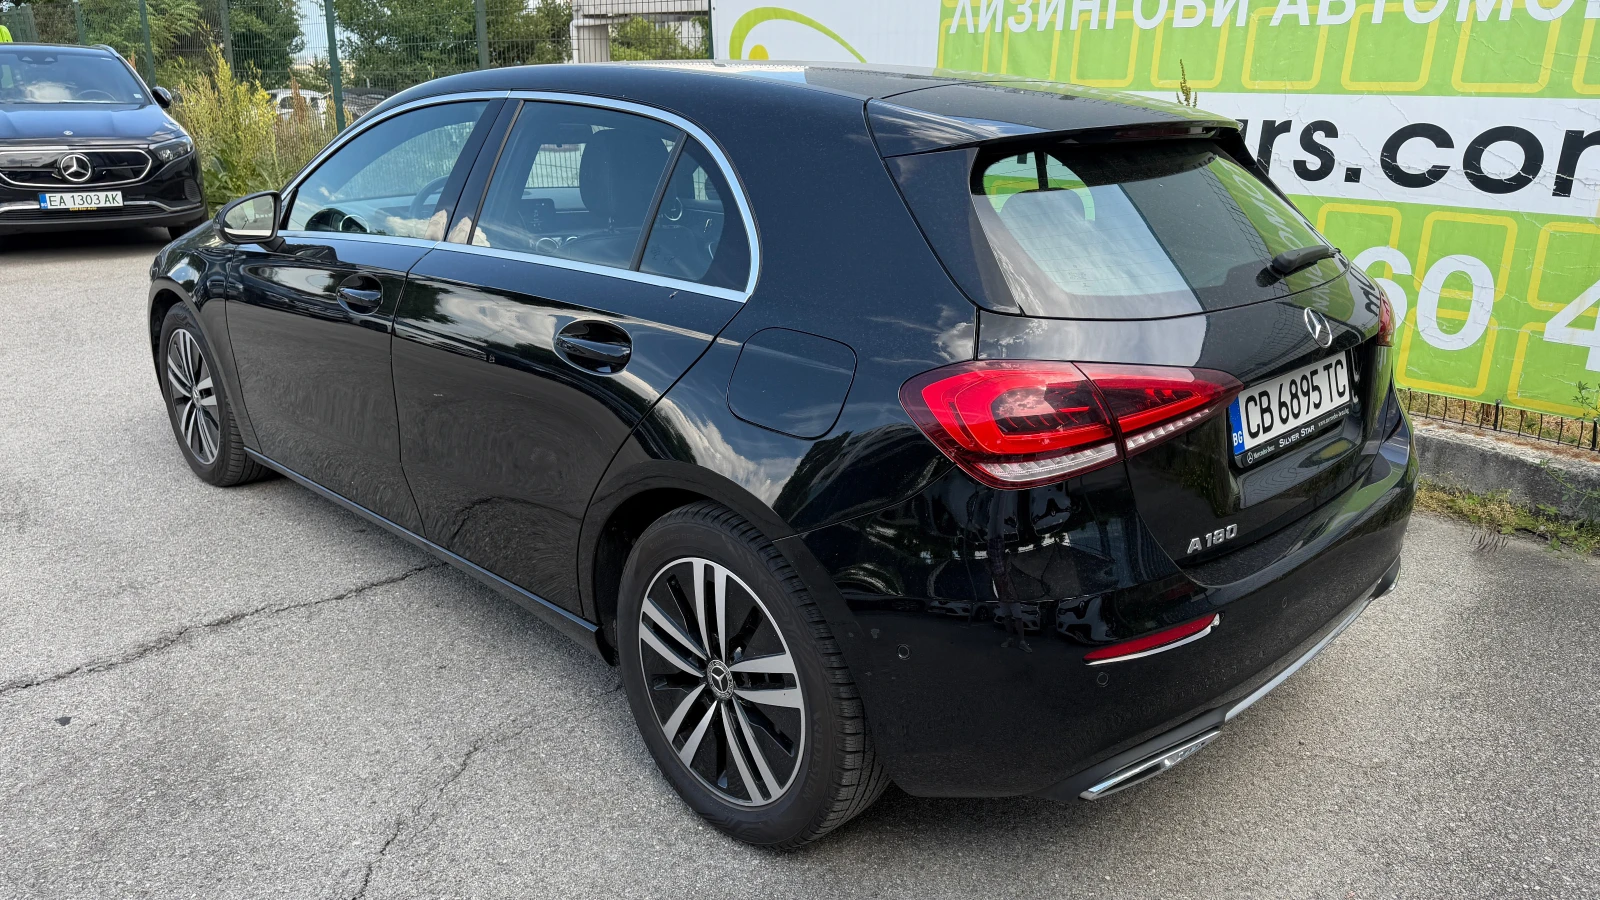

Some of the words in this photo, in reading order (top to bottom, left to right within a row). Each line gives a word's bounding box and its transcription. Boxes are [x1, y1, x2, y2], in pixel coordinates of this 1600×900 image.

[1235, 119, 1600, 198] rs.co
[48, 195, 67, 207] EA
[70, 194, 101, 206] 1303
[104, 193, 120, 205] AK
[1244, 389, 1275, 440] CB
[1278, 369, 1323, 425] 6895
[1323, 358, 1346, 402] TC
[1232, 430, 1244, 446] BG
[1279, 433, 1300, 448] SILVER
[1300, 425, 1315, 437] STAR
[1187, 537, 1203, 554] A
[1206, 523, 1238, 548] 180
